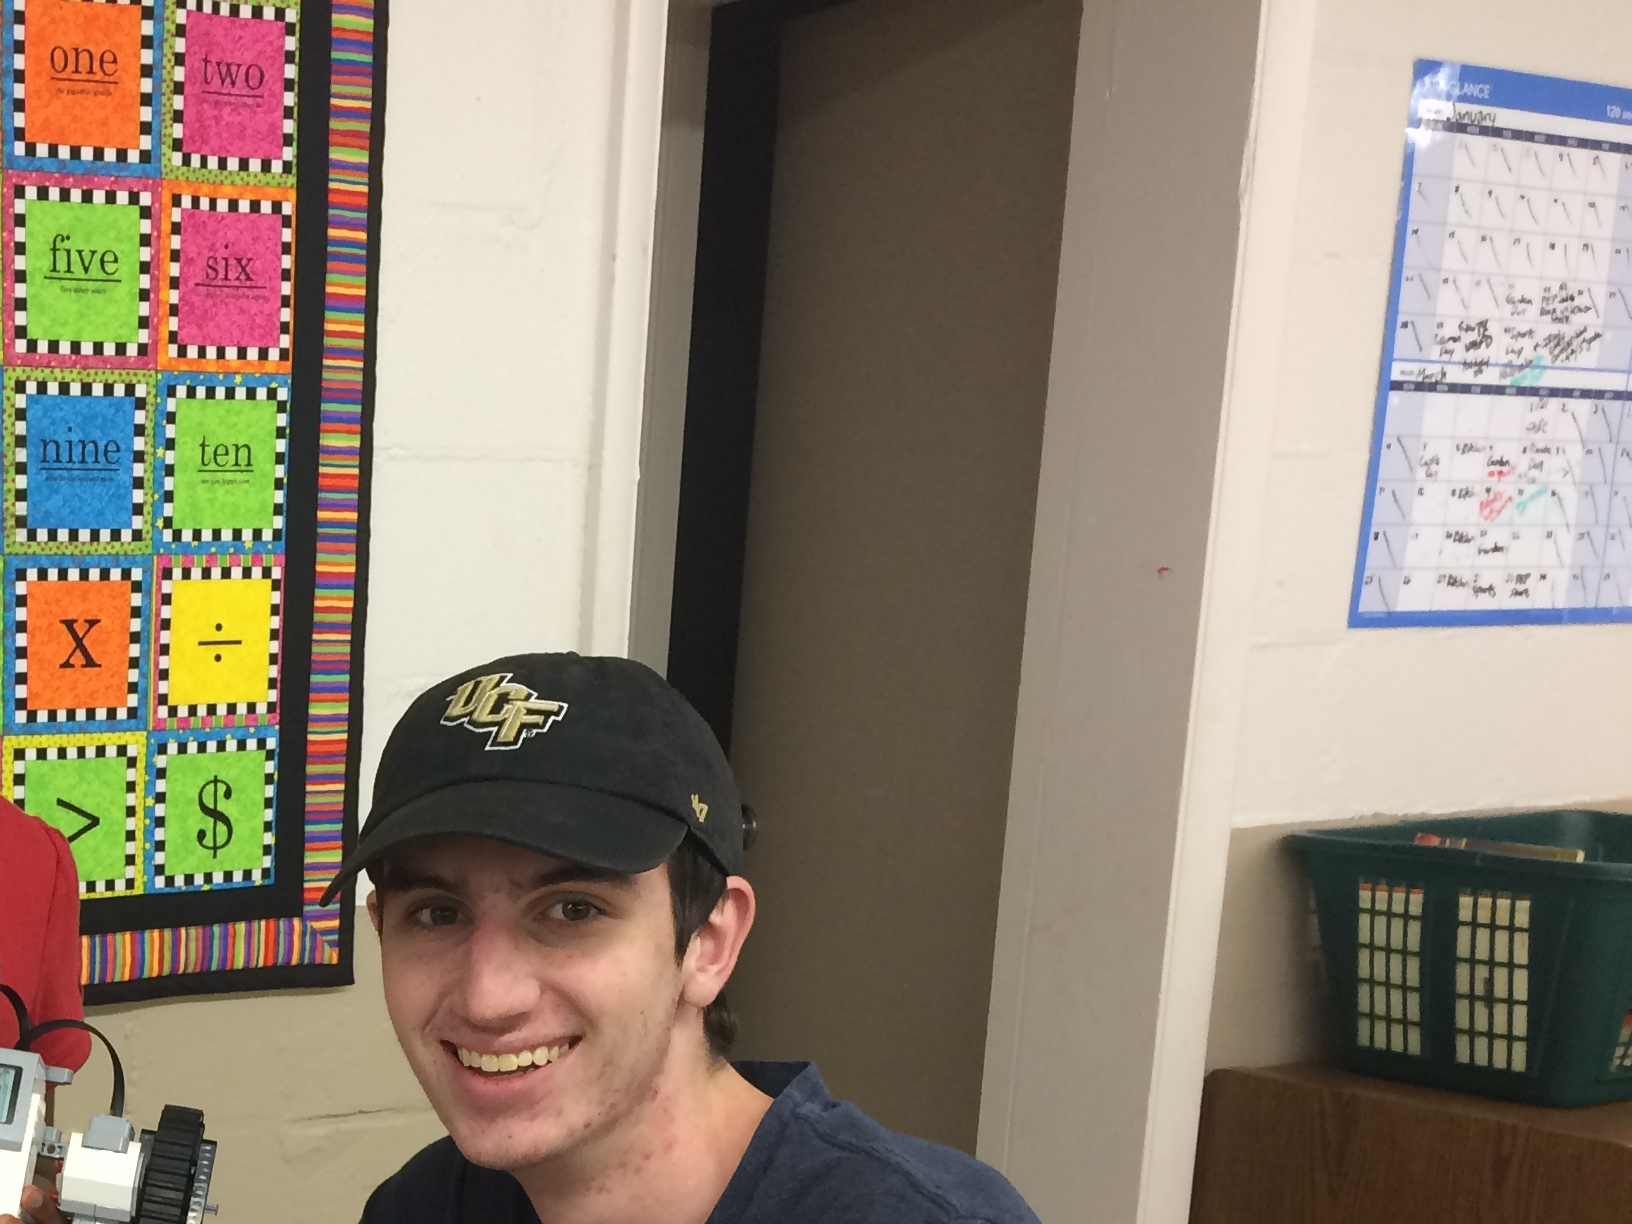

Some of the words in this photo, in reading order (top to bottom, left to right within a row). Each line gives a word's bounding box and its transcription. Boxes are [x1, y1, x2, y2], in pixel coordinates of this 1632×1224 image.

[50, 45, 118, 77] one
[202, 54, 265, 90] two
[49, 233, 119, 276] five
[205, 243, 255, 282] six
[39, 425, 122, 466] nine
[199, 435, 254, 468] ten
[442, 673, 565, 747] UCF
[196, 775, 234, 859] $
